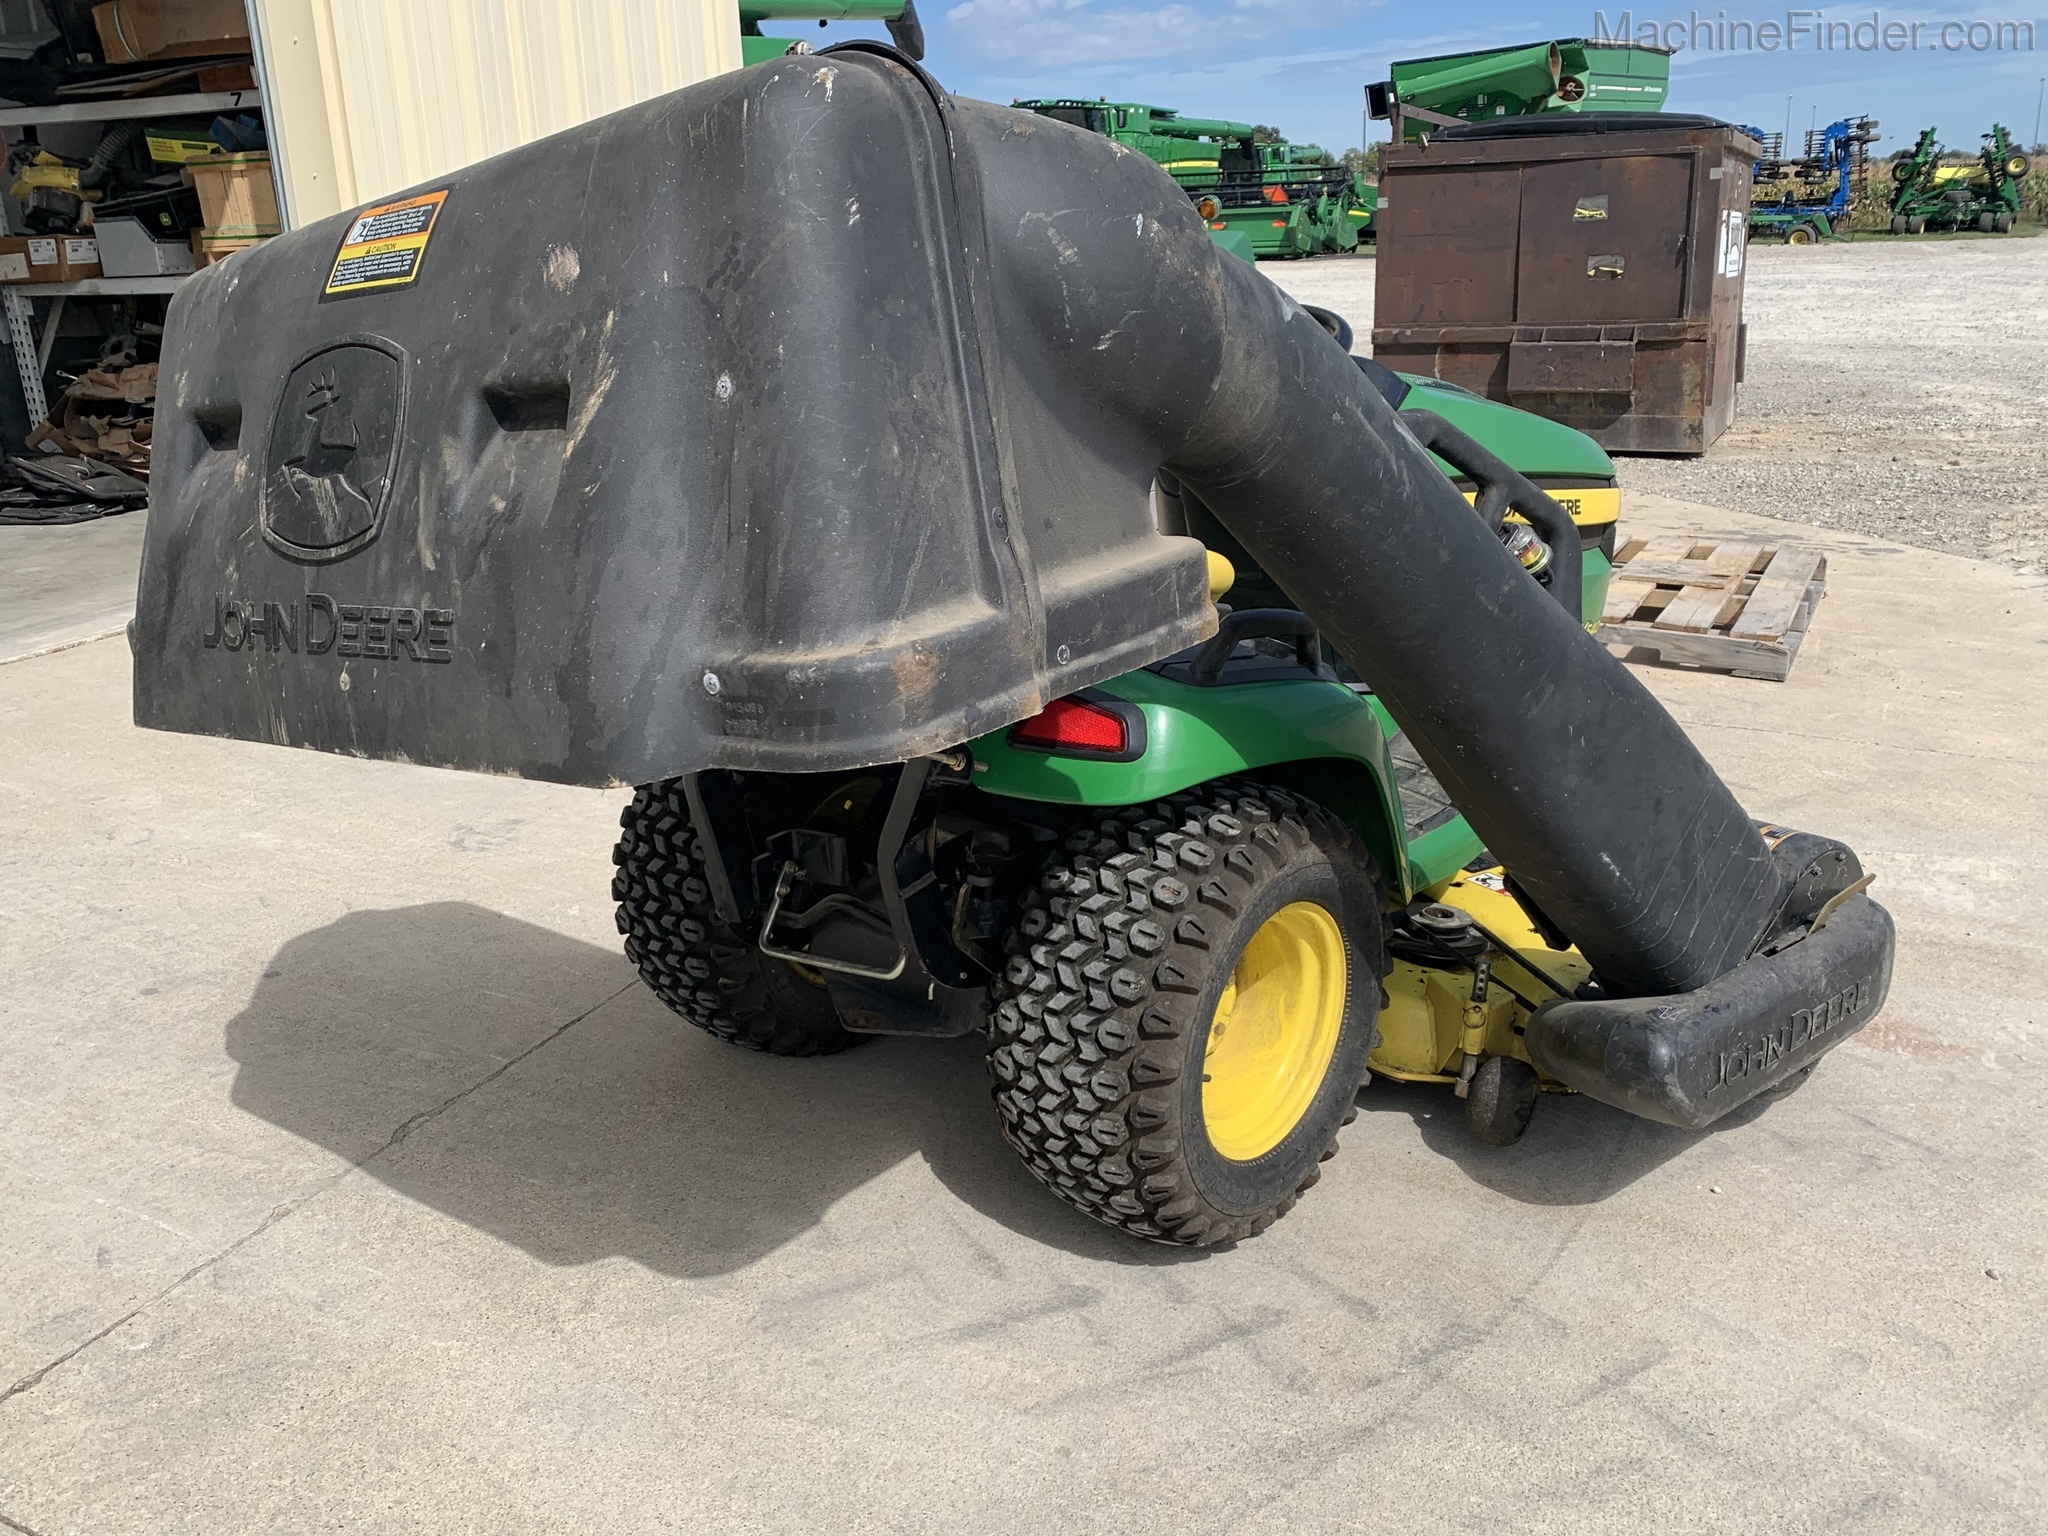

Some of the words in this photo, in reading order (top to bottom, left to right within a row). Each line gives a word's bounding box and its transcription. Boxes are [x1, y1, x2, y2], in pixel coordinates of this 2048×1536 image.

[230, 92, 242, 107] 7
[370, 242, 397, 254] CAUTION
[203, 591, 300, 654] JOHN
[305, 592, 455, 664] DEERE
[1704, 1026, 1790, 1100] JOHN
[1789, 975, 1872, 1053] DEERE
